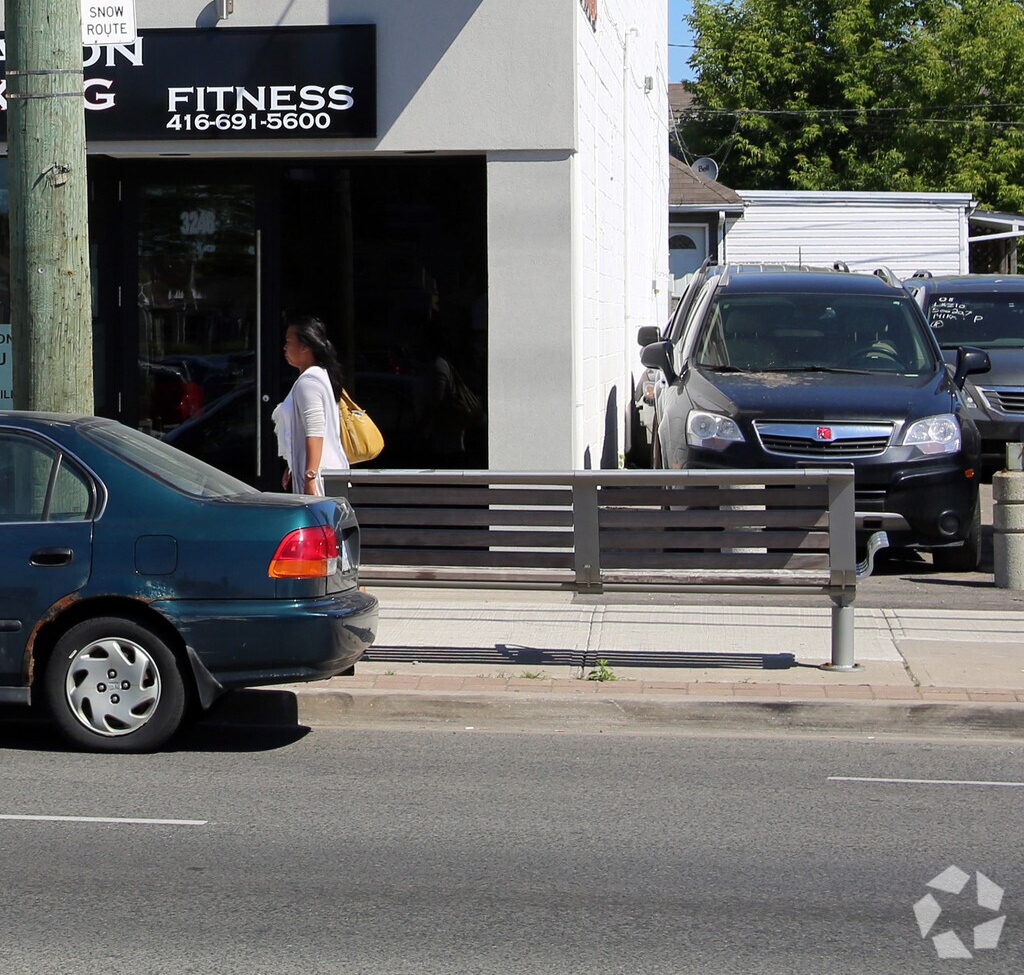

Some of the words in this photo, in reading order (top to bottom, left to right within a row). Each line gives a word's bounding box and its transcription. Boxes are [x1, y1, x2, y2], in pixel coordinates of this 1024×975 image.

[89, 5, 124, 18] SNOW
[87, 22, 127, 36] ROUTE
[167, 84, 355, 113] FITNESS
[166, 112, 331, 132] 416-691-5600
